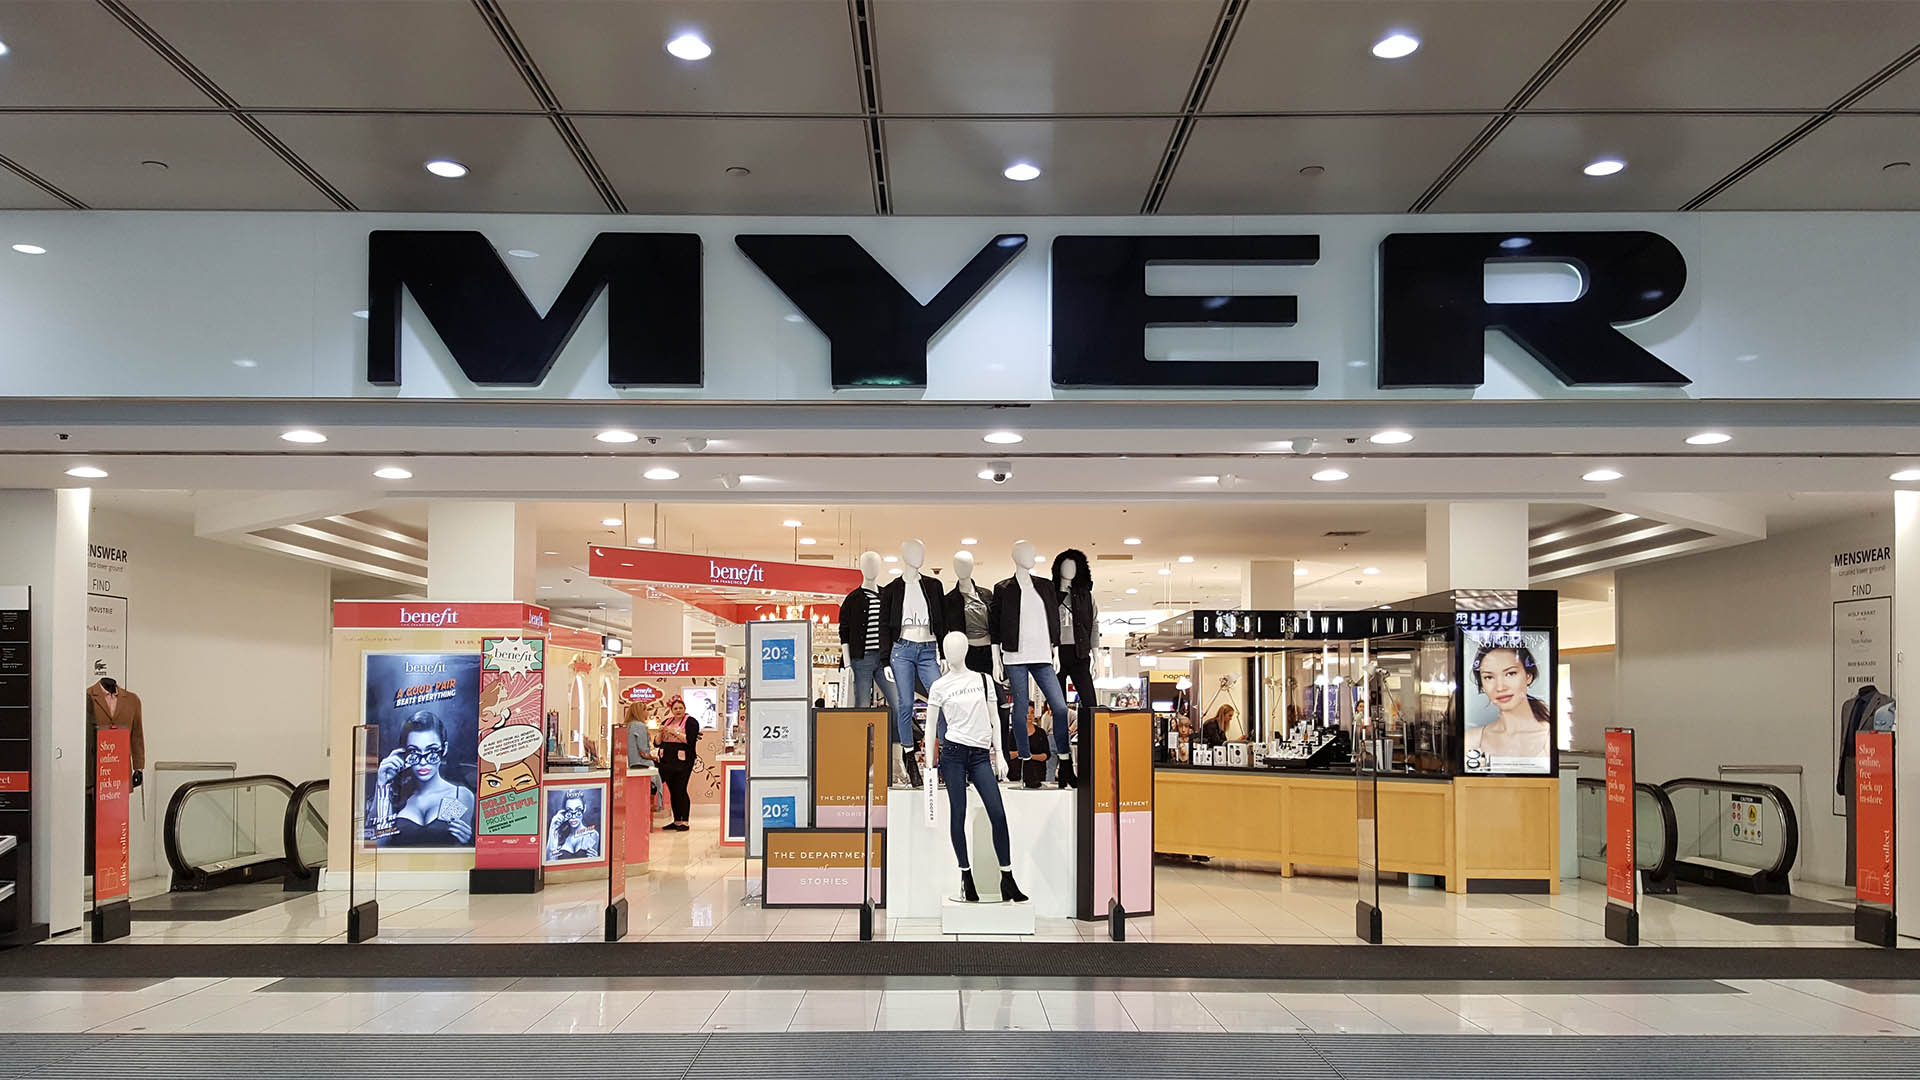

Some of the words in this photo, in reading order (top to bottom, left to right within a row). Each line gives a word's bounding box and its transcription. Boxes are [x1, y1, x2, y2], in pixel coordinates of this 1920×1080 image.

[366, 230, 1692, 390] MYER
[87, 543, 128, 563] NSWEAR
[1834, 546, 1891, 567] MENSWEAR
[709, 560, 764, 584] benefit
[92, 578, 111, 592] FIND
[1852, 583, 1872, 597] FIND
[89, 606, 113, 615] INDUSTRIE
[399, 607, 459, 627] benefit
[528, 608, 544, 627] benefit
[1203, 616, 1261, 633] BOBBI
[1280, 611, 1344, 634] BROWN
[494, 647, 533, 663] benefit
[762, 647, 789, 660] 20%
[404, 661, 447, 675] benefit
[644, 659, 690, 675] benefit
[396, 688, 403, 699] A
[405, 682, 433, 696] GOOD
[434, 678, 457, 691] PAIR
[396, 694, 418, 707] BEATS
[417, 688, 456, 703] EVERYTHING
[762, 725, 789, 739] 25%
[100, 741, 115, 753] Shop
[1858, 744, 1876, 757] Shop
[100, 766, 112, 776] free
[1859, 768, 1872, 779] free
[99, 777, 113, 791] pick
[113, 780, 121, 790] up
[1859, 781, 1873, 796] pick
[1873, 784, 1883, 795] up
[481, 795, 507, 810] BOLD
[507, 793, 516, 802] IS
[483, 796, 538, 820] BEAUTIFUL
[762, 804, 790, 818] 20%
[485, 812, 515, 825] PROJECT
[774, 851, 796, 859] THE
